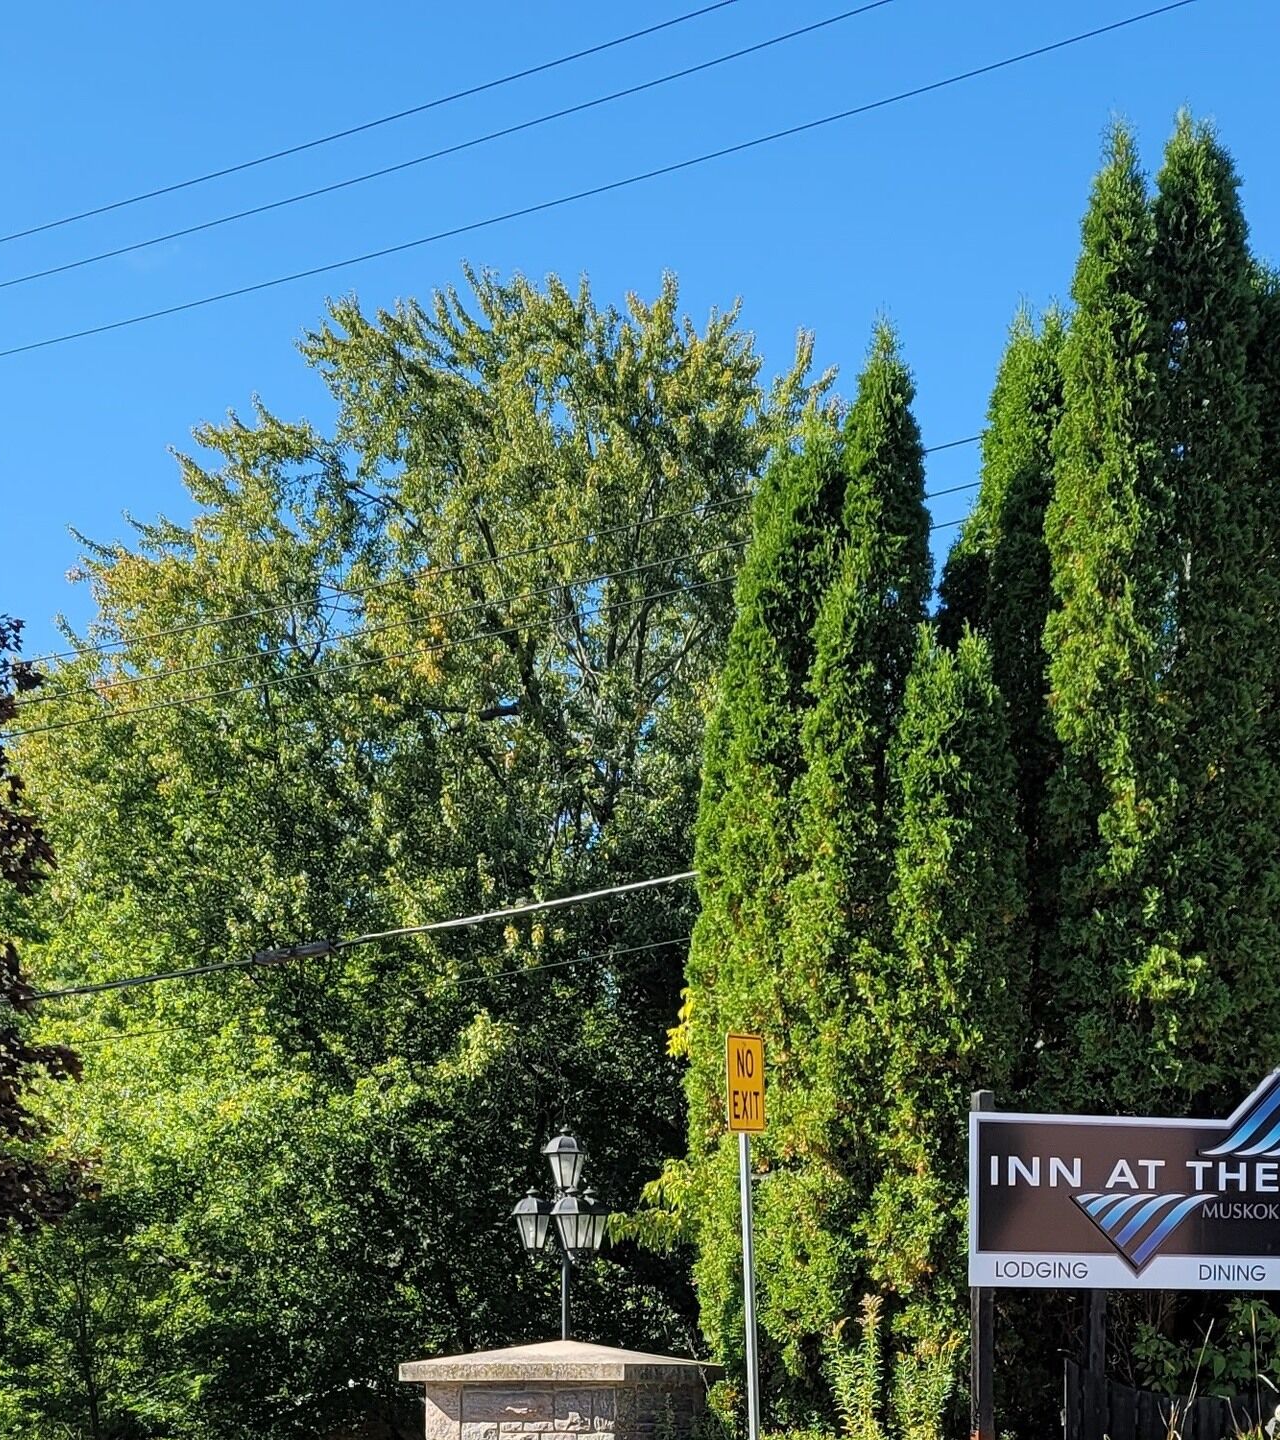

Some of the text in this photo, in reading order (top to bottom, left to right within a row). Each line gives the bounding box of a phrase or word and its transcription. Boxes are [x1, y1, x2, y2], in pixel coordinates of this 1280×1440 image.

[736, 1048, 754, 1078] NO
[733, 1090, 760, 1120] EXIT
[990, 1154, 1082, 1188] INN
[1105, 1159, 1166, 1190] AT
[1186, 1160, 1280, 1193] THE
[995, 1261, 1089, 1280] LODGING
[1199, 1264, 1267, 1282] DINING
